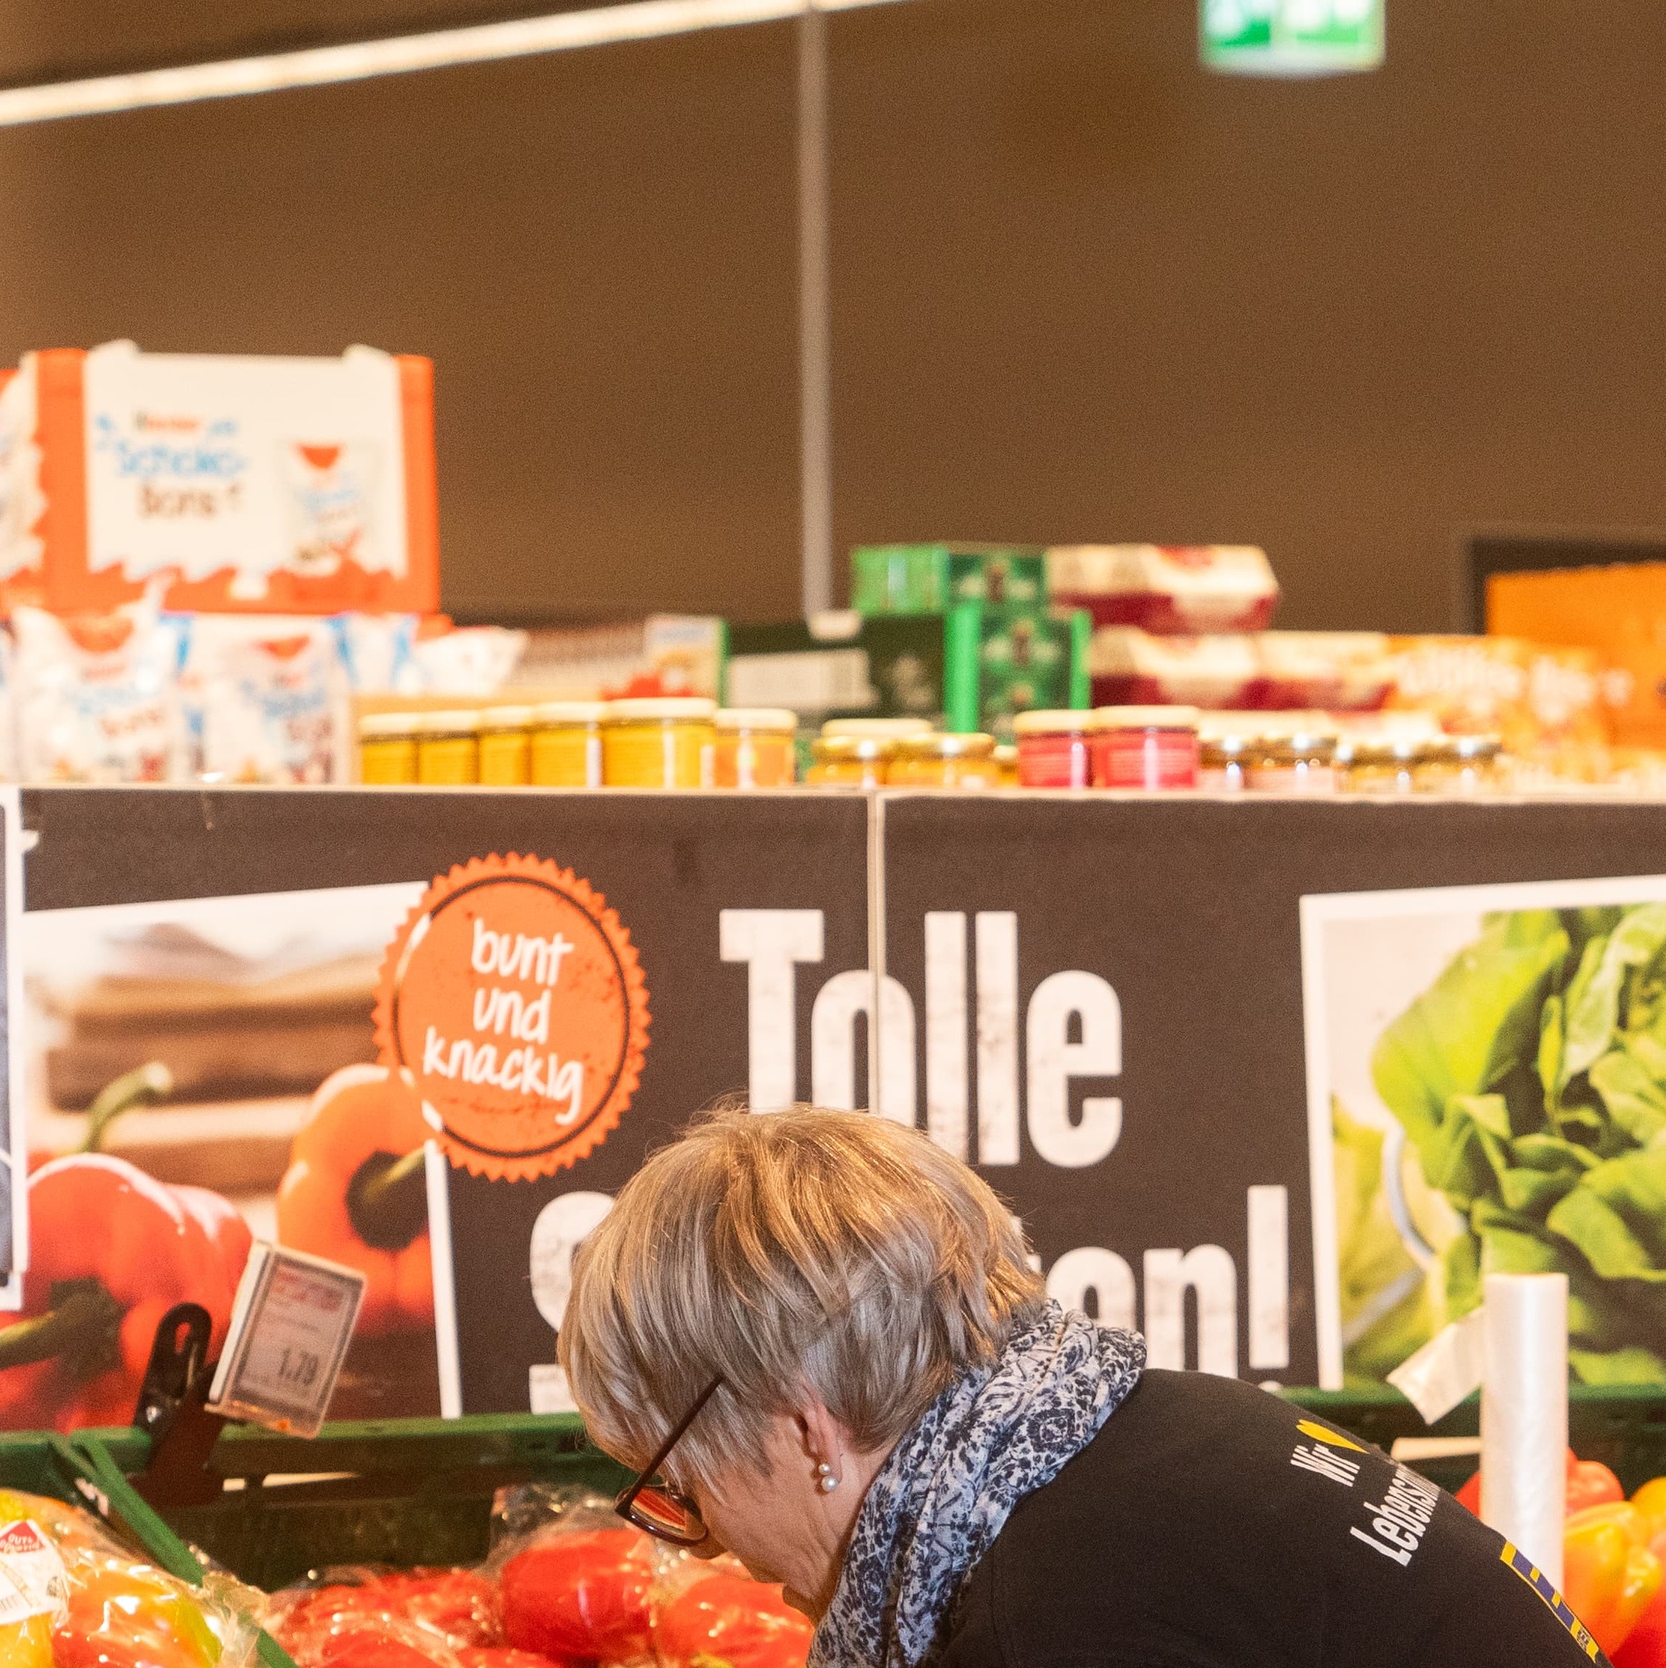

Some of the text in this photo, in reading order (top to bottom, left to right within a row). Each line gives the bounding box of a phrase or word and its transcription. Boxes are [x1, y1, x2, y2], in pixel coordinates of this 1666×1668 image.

[470, 917, 574, 988] bunt
[471, 985, 553, 1045] und
[719, 907, 1123, 1170] Tolle
[422, 1026, 585, 1126] knackig
[1290, 1443, 1361, 1488] Wir
